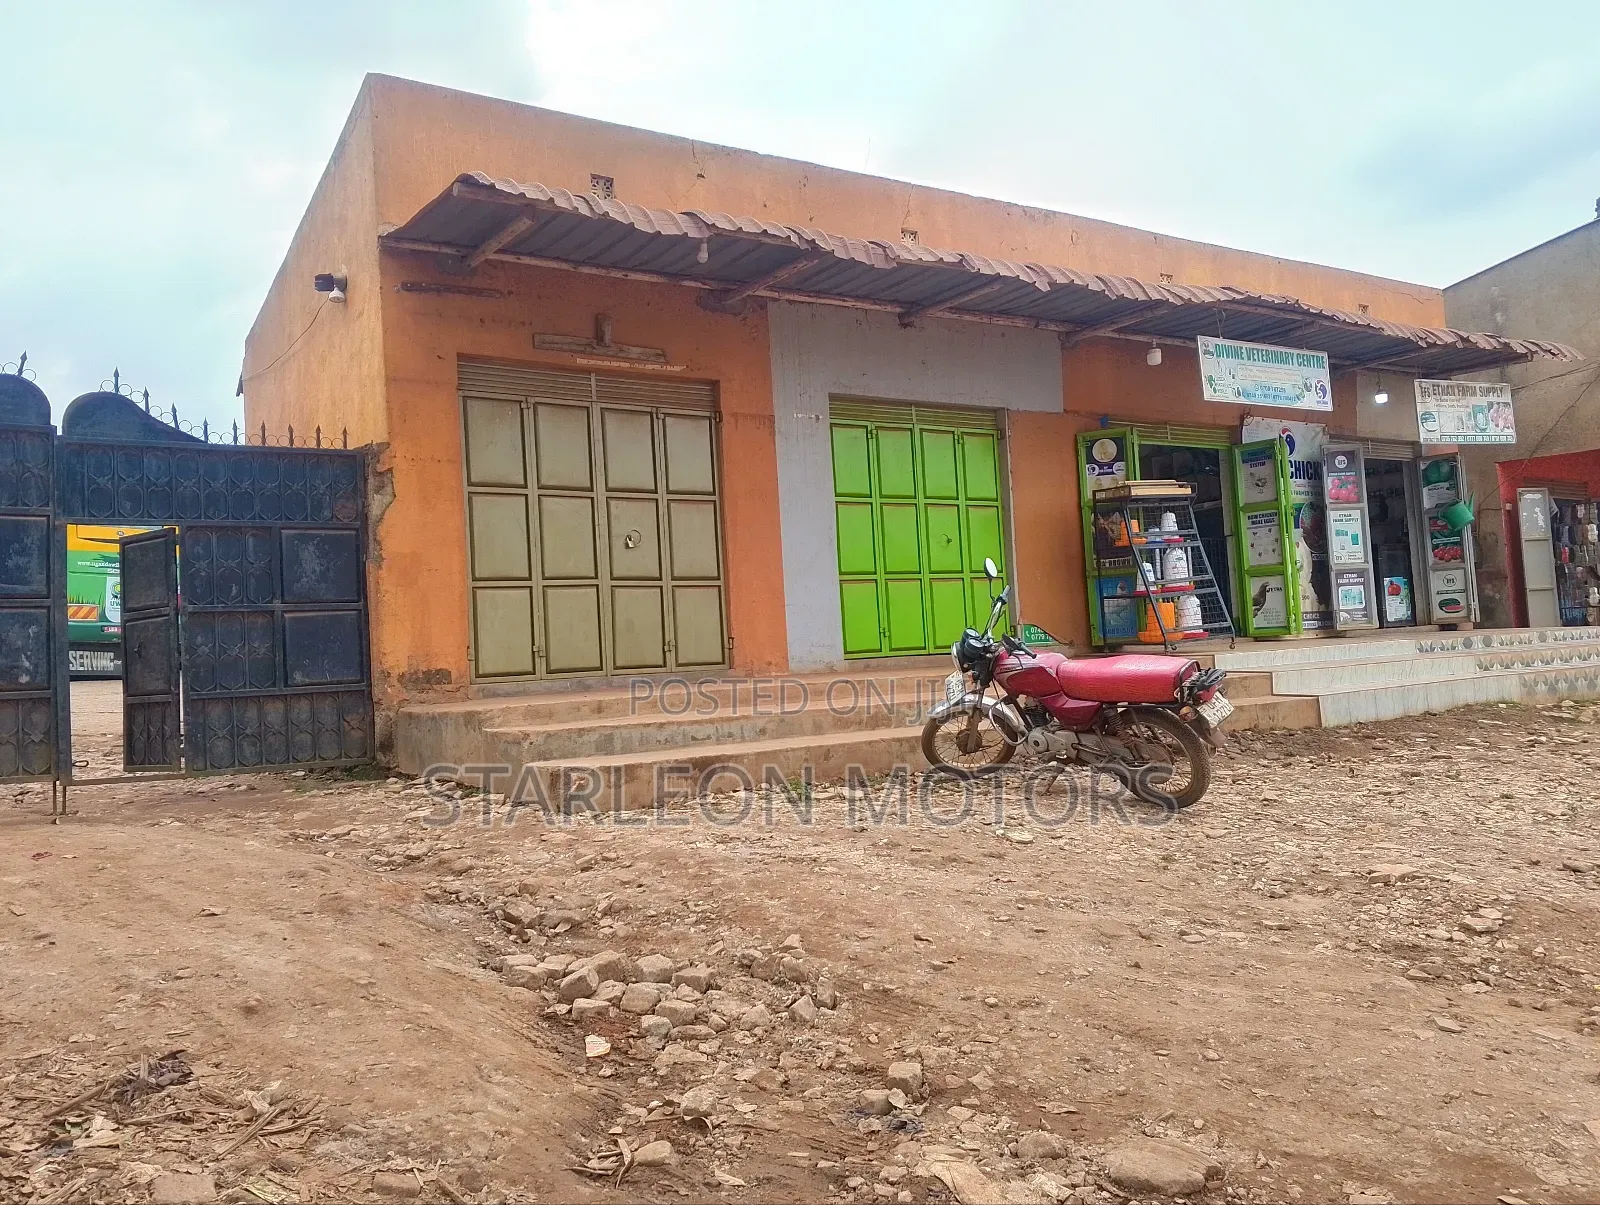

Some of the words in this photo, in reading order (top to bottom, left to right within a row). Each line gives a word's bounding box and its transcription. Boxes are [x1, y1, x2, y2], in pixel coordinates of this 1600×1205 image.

[1214, 343, 1244, 361] DIVINE
[1245, 346, 1294, 366] VETERINARY
[1296, 352, 1326, 370] CENTRE
[1432, 384, 1456, 396] ETHAN
[1458, 385, 1478, 398] FARM
[1478, 386, 1504, 398] SUPPLY
[1098, 558, 1131, 568] A-BROWN
[68, 650, 114, 671] SERVING
